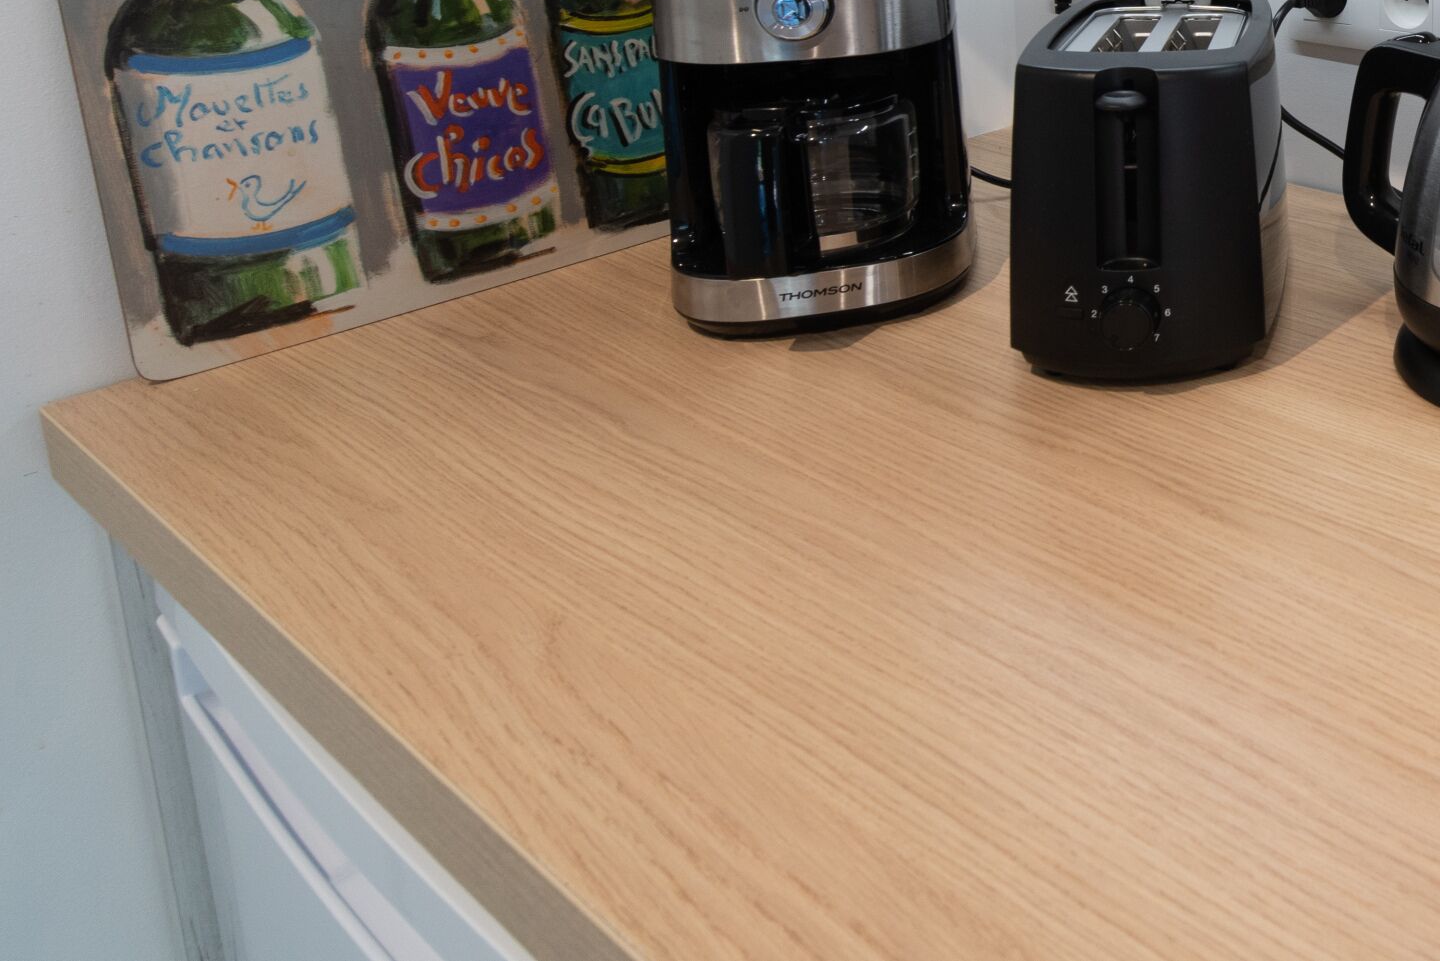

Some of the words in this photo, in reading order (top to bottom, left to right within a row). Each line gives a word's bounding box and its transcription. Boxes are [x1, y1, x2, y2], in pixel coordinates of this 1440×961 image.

[406, 69, 533, 126] Veuve
[1127, 275, 1134, 284] 4
[778, 282, 863, 302] THOMSON
[1101, 285, 1108, 294] 3
[1153, 284, 1160, 293] 5
[1090, 309, 1098, 318] 2
[1164, 308, 1171, 317] 6
[1153, 333, 1160, 343] 7
